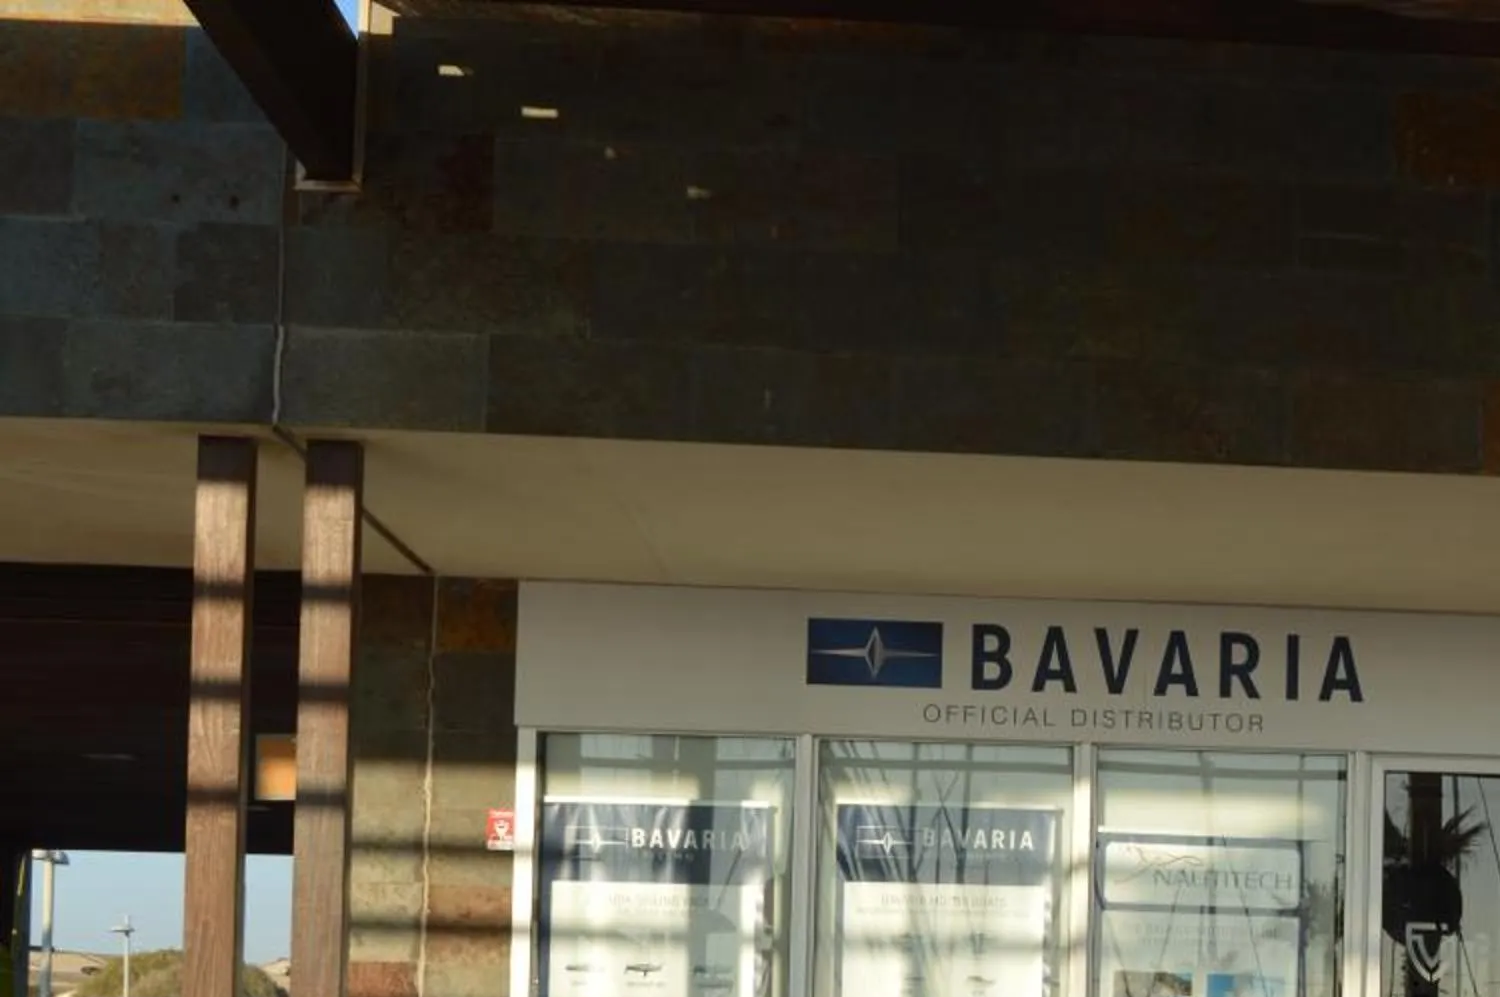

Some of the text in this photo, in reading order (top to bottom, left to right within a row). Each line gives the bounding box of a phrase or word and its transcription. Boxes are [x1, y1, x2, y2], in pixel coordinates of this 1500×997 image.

[971, 623, 1365, 702] BAVARIA
[922, 704, 1264, 733] OFFICIAL DISTRIBUTOR
[630, 828, 746, 850] BAVARIA
[922, 828, 1035, 851] BAVARIA
[1153, 869, 1294, 890] NAUTITECH
